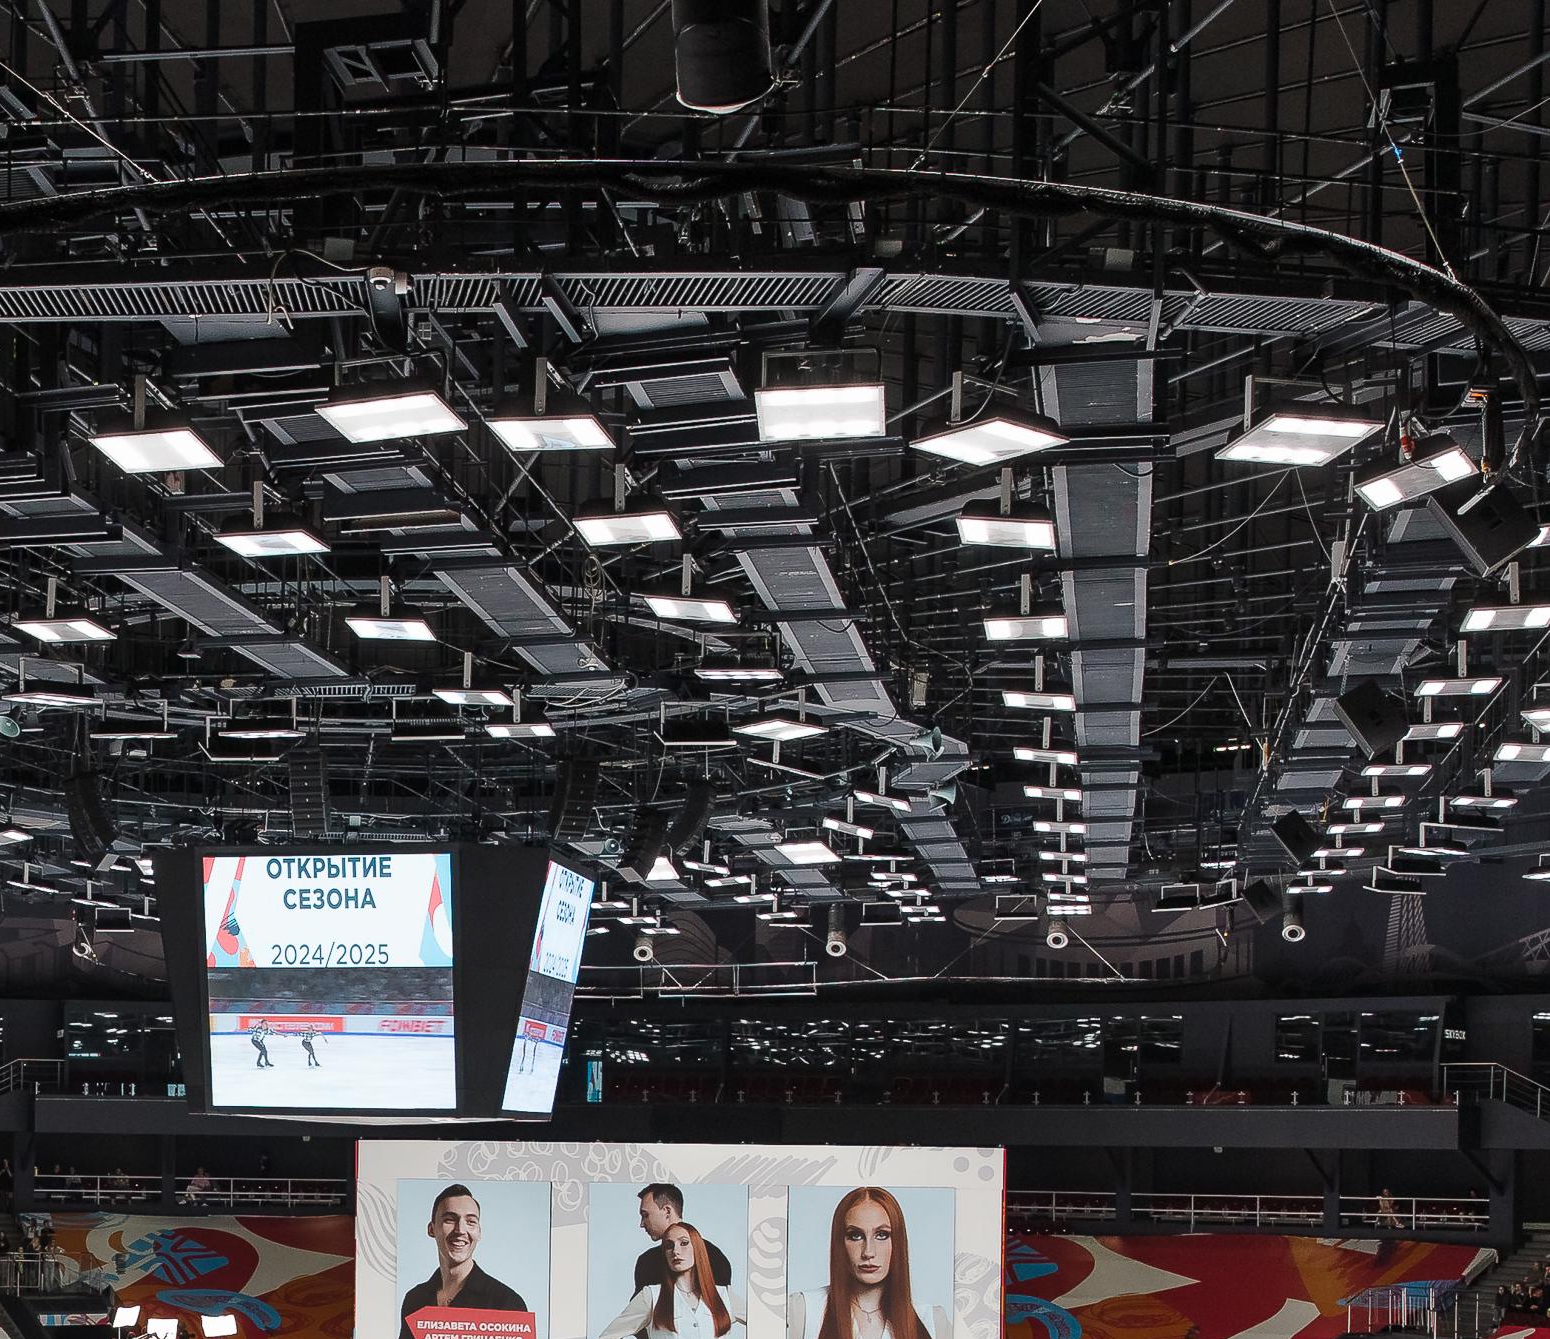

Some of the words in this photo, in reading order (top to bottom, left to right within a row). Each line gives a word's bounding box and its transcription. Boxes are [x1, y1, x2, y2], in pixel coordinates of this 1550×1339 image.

[266, 857, 392, 879] ОТКРЫТИЕ
[283, 888, 377, 910] СЕЗОНА
[271, 942, 389, 968] 2024/2025
[416, 1320, 477, 1332] ЕЛИЗАВЕТА
[479, 1322, 531, 1333] ОСОКИНА
